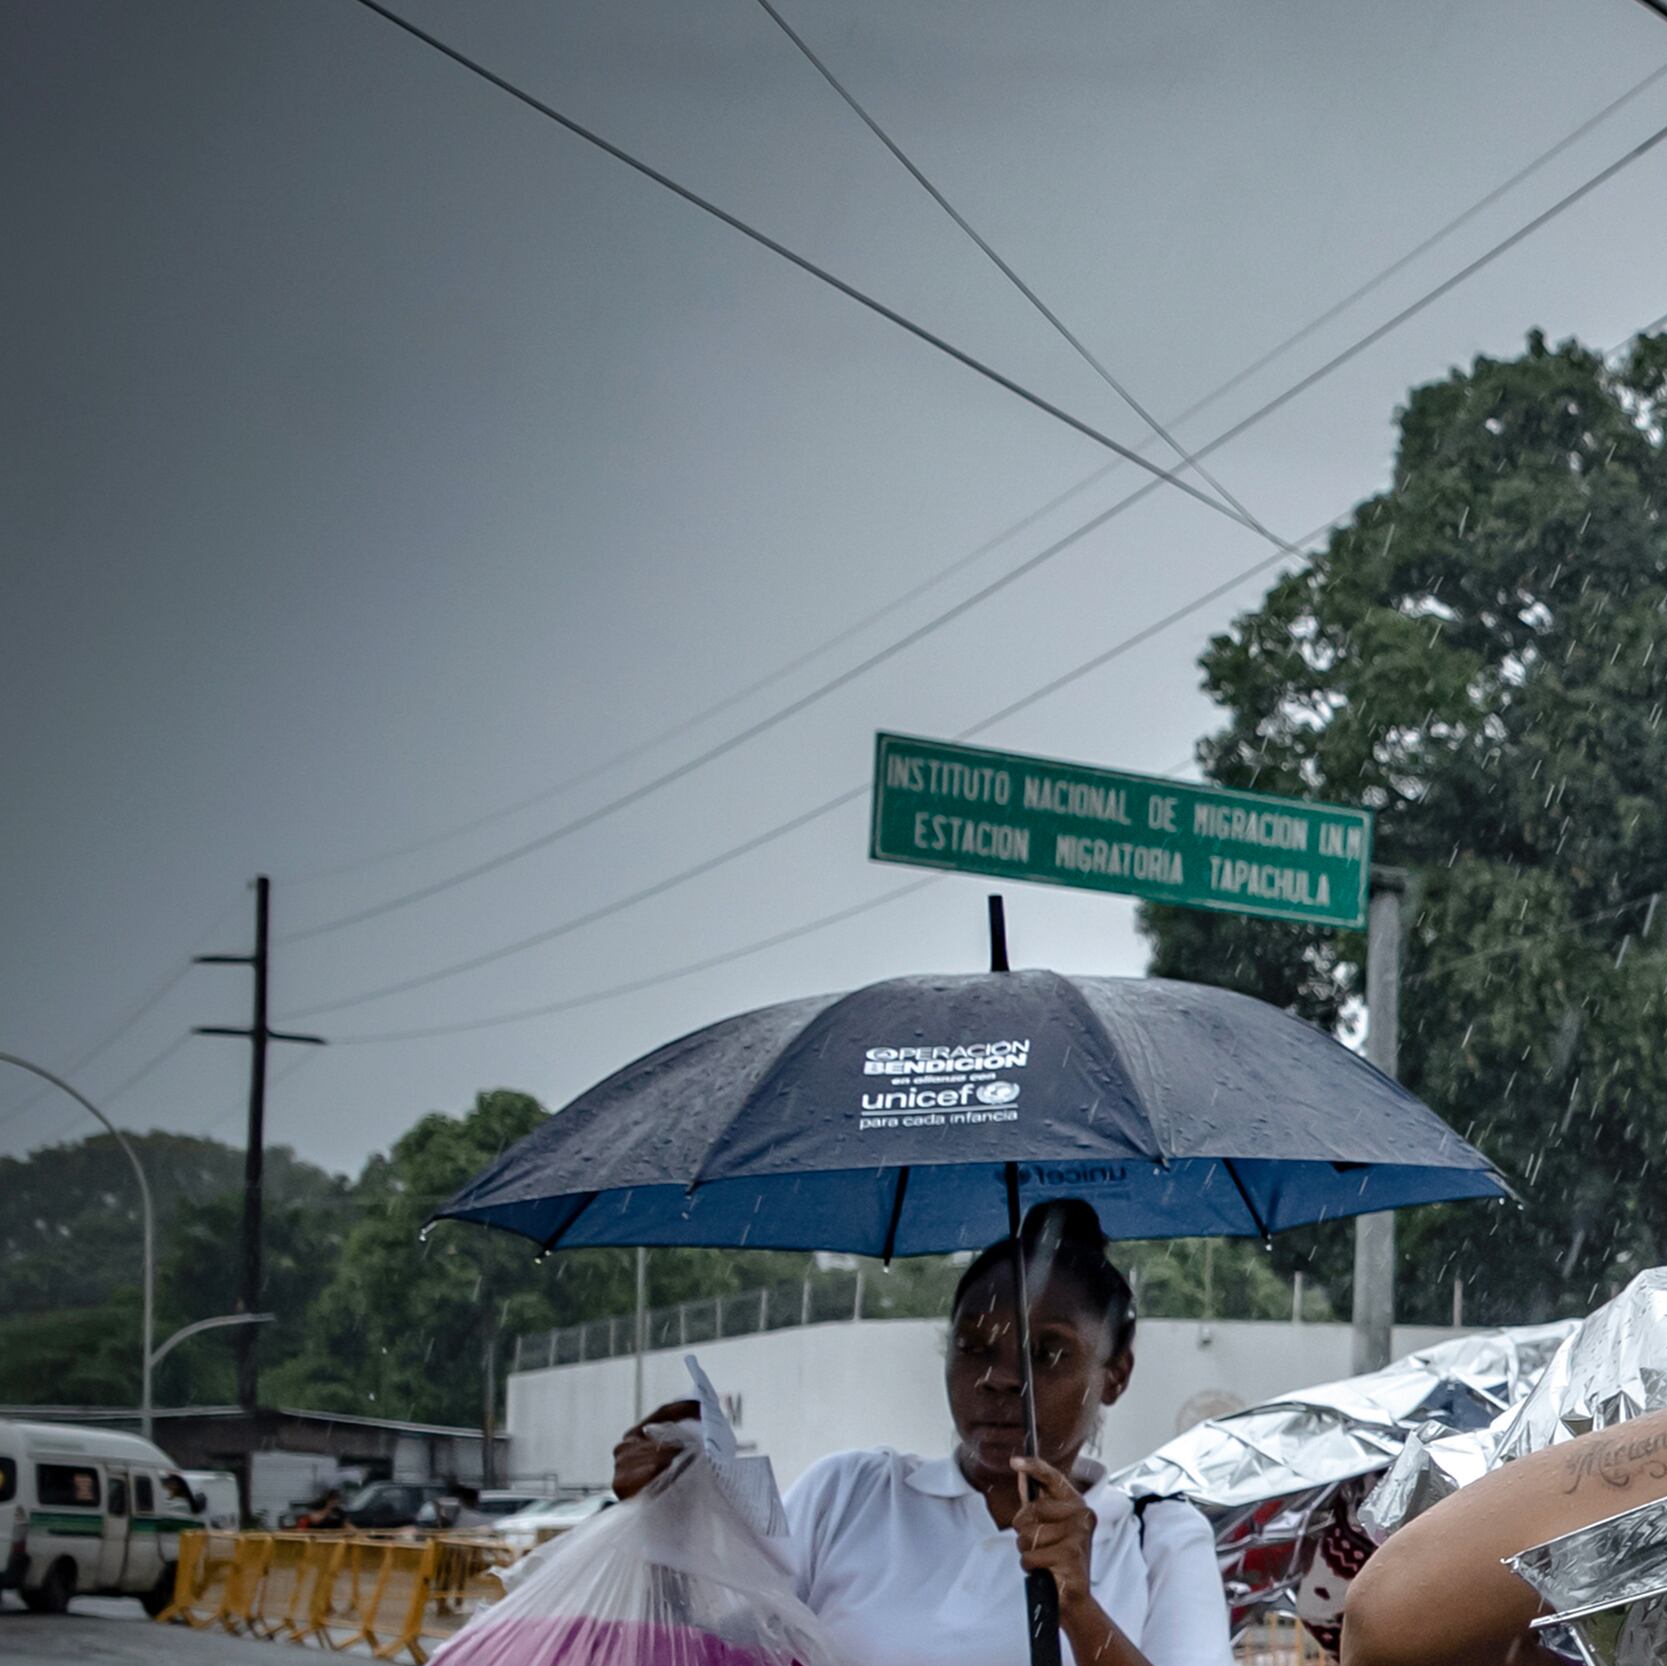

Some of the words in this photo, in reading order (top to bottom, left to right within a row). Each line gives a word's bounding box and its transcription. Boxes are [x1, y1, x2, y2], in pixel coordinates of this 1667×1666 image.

[886, 753, 1011, 806] INSTITUTO
[1023, 775, 1132, 826] NACIONAL
[1148, 795, 1178, 833] DE
[1193, 802, 1308, 851] MIGRACION
[914, 811, 1030, 864] ESTACION
[1055, 833, 1184, 885] MIGRATORIA
[1210, 855, 1331, 906] TAPACHULA
[859, 1118, 899, 1131] para
[903, 1113, 945, 1127] cada
[950, 1109, 1018, 1125] infancia
[862, 1083, 975, 1110] unicef
